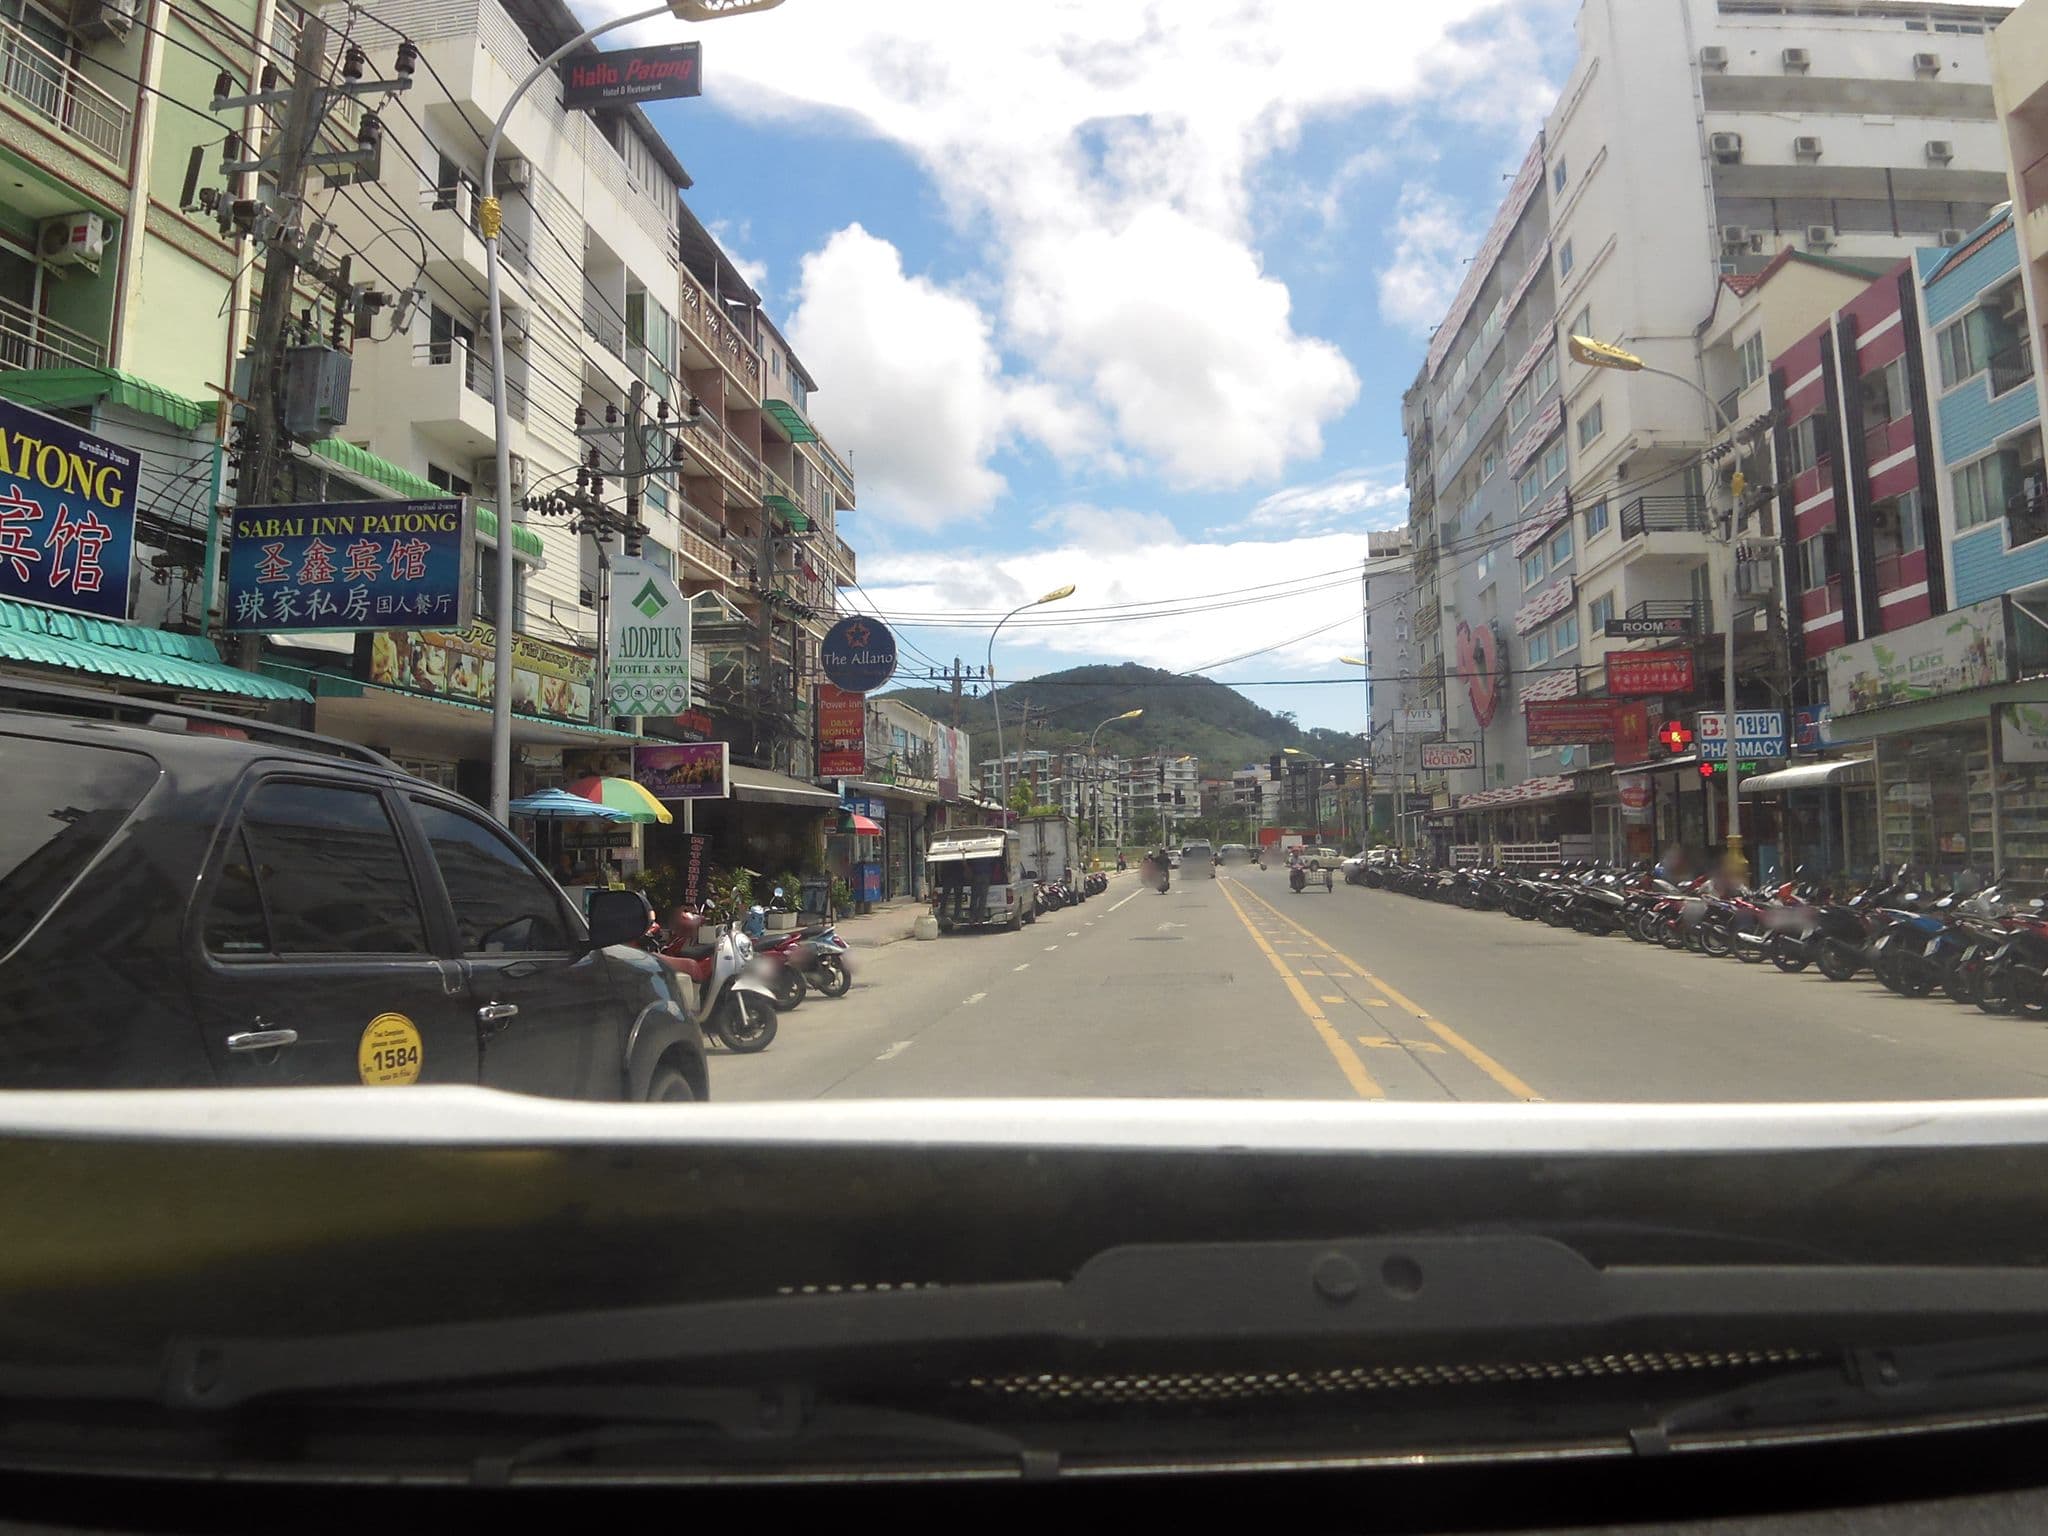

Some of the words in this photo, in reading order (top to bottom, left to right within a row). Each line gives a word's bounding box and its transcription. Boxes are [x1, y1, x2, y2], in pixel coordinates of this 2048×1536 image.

[625, 59, 693, 81] Patong
[238, 518, 304, 538] SABAI
[311, 516, 356, 535] INN
[362, 513, 457, 534] PATONG
[255, 537, 430, 585] 圣鑫宾馆
[618, 626, 683, 659] ADDPLUS
[823, 653, 847, 665] The
[851, 651, 894, 665] Allano
[615, 664, 651, 675] HOTEL
[652, 664, 662, 674] &
[664, 664, 685, 674] SPA
[820, 699, 846, 710] Power
[830, 719, 854, 728] DAILY
[821, 727, 862, 737] MONTHLY
[1424, 755, 1473, 766] HOLIDAY
[373, 1046, 418, 1071] 1584
